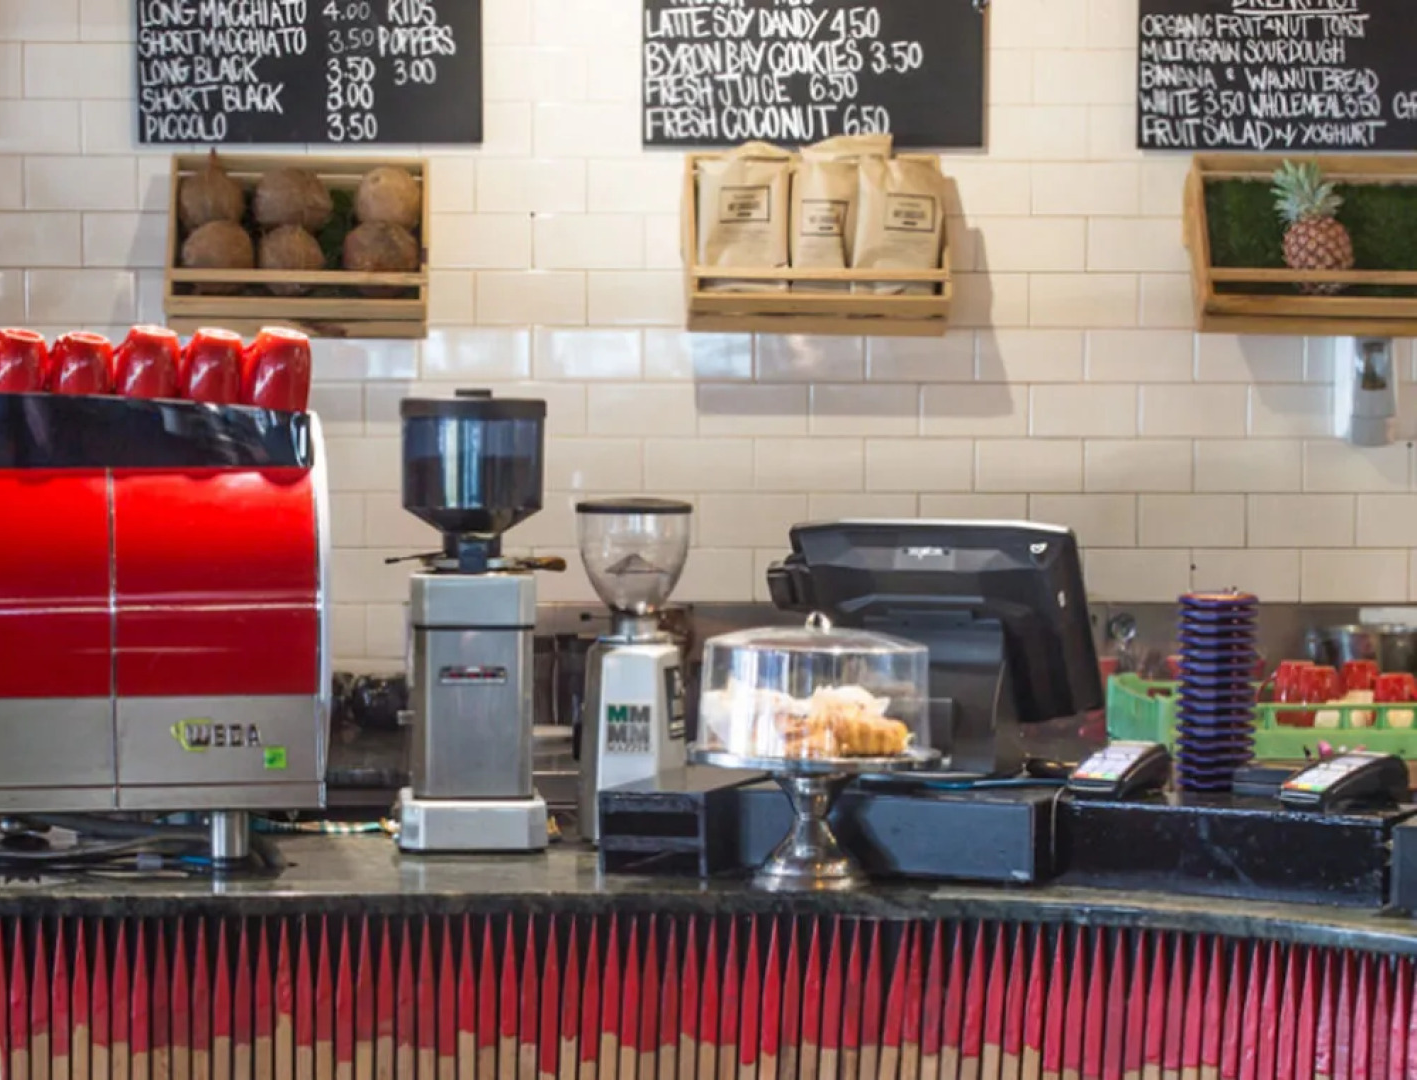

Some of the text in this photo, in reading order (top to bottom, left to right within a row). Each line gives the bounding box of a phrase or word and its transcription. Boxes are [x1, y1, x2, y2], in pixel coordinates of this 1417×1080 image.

[140, 0, 370, 27] LONG MACCHIATO 4.00
[387, 0, 437, 25] KIDS
[645, 7, 711, 38] LATTE
[712, 7, 755, 38] SOY
[759, 7, 828, 40] DANDY
[1141, 13, 1213, 37] ORGANIC
[1215, 13, 1266, 38] FRUIT
[1275, 14, 1315, 38] NUT
[1316, 14, 1370, 38] TOAST
[139, 27, 375, 58] SHORT MACCHIATO 3.50
[378, 24, 456, 57] POPPERS
[1141, 38, 1346, 64] MULTIGRAIN SOURDOUGH
[140, 53, 376, 86] LONG BLACK 3.50
[645, 38, 923, 76] BYRON BAY COOKIES 3.50
[645, 75, 713, 106] FRESH
[714, 73, 792, 105] JUICE
[1141, 62, 1218, 89] BANANA
[1323, 67, 1379, 93] BREAD
[140, 82, 374, 114] SHORT BLACK 3.00
[1140, 88, 1200, 116] WHITE
[1249, 91, 1345, 118] WHOLEMEAL
[146, 112, 378, 142] PICCOLO 3.50
[645, 107, 717, 140] FRESH
[721, 105, 837, 139] COCONUT
[1141, 115, 1201, 146] FRUIT
[1202, 116, 1274, 149] SALAD
[1299, 121, 1387, 146] YOGHURT
[186, 722, 261, 747] WEGA
